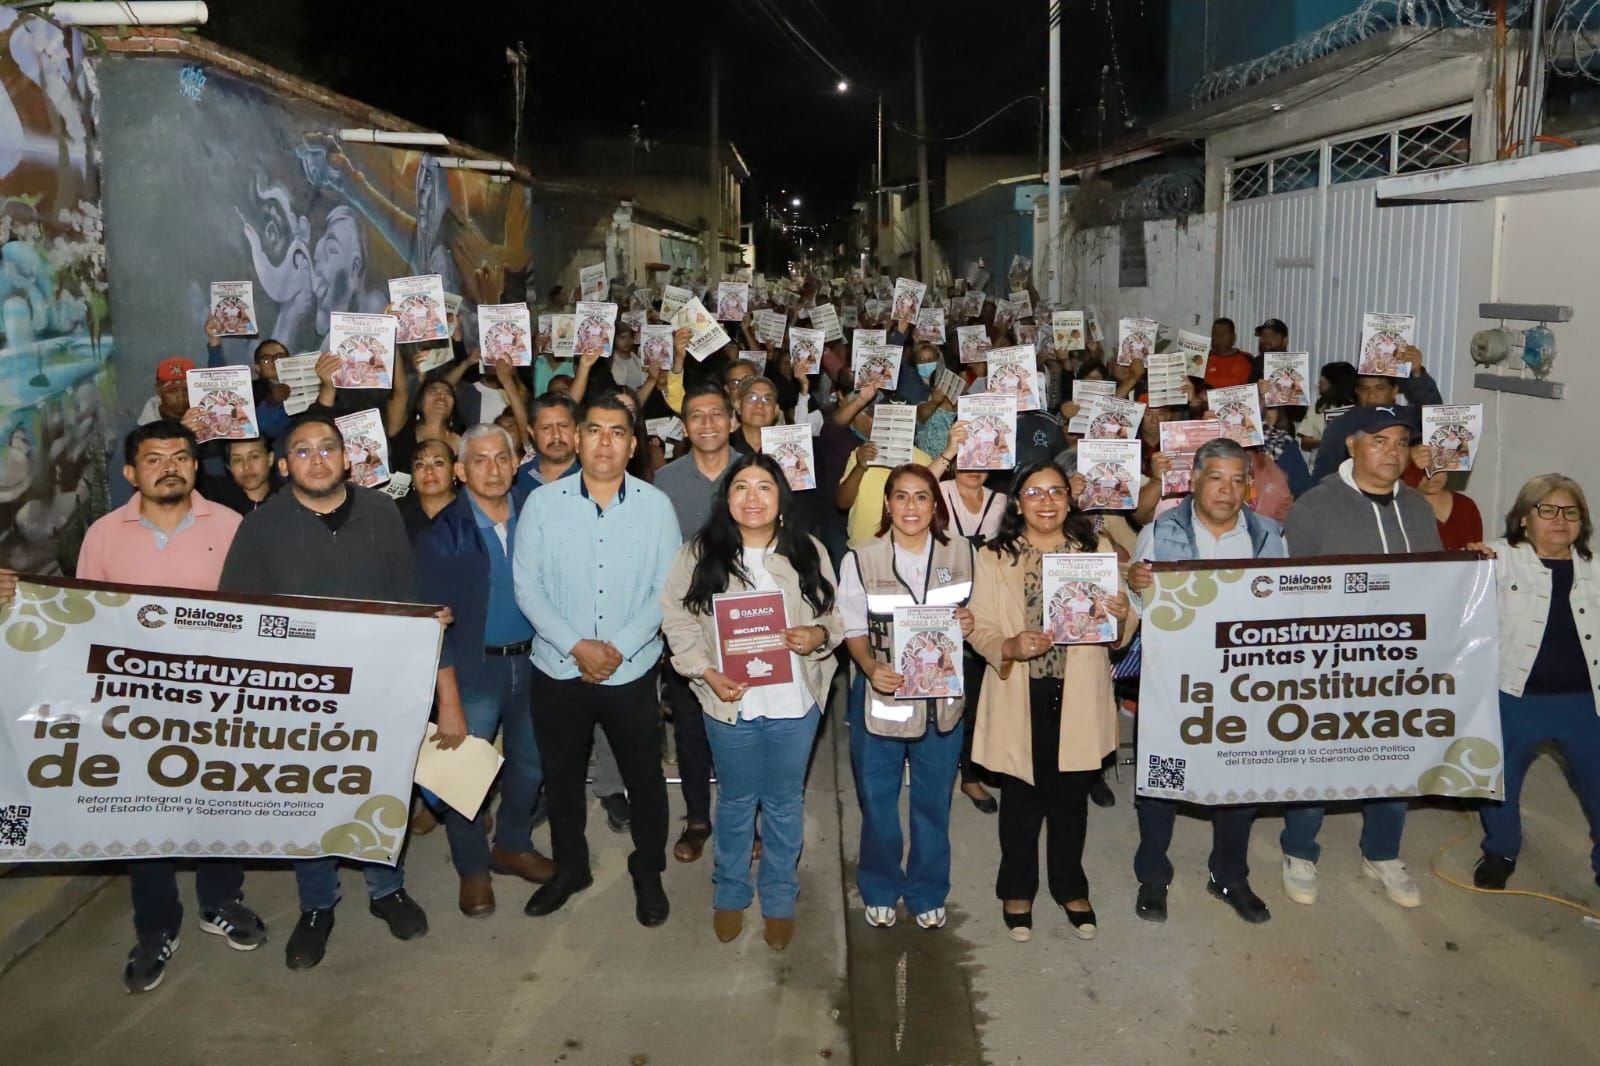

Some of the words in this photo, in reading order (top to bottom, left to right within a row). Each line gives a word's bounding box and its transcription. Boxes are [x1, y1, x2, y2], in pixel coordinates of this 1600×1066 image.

[1279, 574, 1332, 586] Diálogos
[1279, 582, 1332, 592] Interculturales
[175, 606, 244, 623] Diálogos
[741, 607, 774, 616] OAXACA
[174, 617, 243, 630] Interculturales
[1228, 619, 1413, 647] Construyamos
[1220, 649, 1306, 673] juntas
[1311, 649, 1328, 669] y
[1331, 643, 1418, 667] juntos
[106, 649, 335, 692] Construyamos
[1180, 674, 1214, 704] la
[1230, 667, 1456, 702] Constitución
[91, 675, 202, 704] juntas
[209, 689, 230, 713] y
[235, 688, 338, 714] juntos
[33, 704, 80, 739] la
[102, 705, 378, 752] Constitución
[1180, 706, 1246, 745] de
[1267, 702, 1456, 742] Oaxaca
[1217, 750, 1258, 758] Reforma
[1260, 748, 1296, 758] Integral
[1308, 748, 1317, 756] la
[1319, 746, 1378, 755] Constitución
[1225, 758, 1240, 766] del
[1242, 756, 1274, 765] Estado
[1276, 756, 1299, 764] Libre
[1300, 757, 1307, 765] y
[1309, 754, 1356, 763] Soberano
[1358, 754, 1370, 762] de
[1372, 753, 1410, 761] Oaxaca
[27, 742, 120, 788] de
[147, 744, 372, 795] Oaxaca
[77, 796, 132, 804] Reforma
[135, 795, 182, 806] Integral
[195, 797, 205, 806] la
[208, 799, 281, 809] Constitución
[87, 804, 107, 813] del
[110, 804, 153, 813] Estado
[156, 804, 184, 812] Libre
[187, 806, 194, 815] y
[196, 806, 252, 816] Soberano
[254, 808, 270, 816] de
